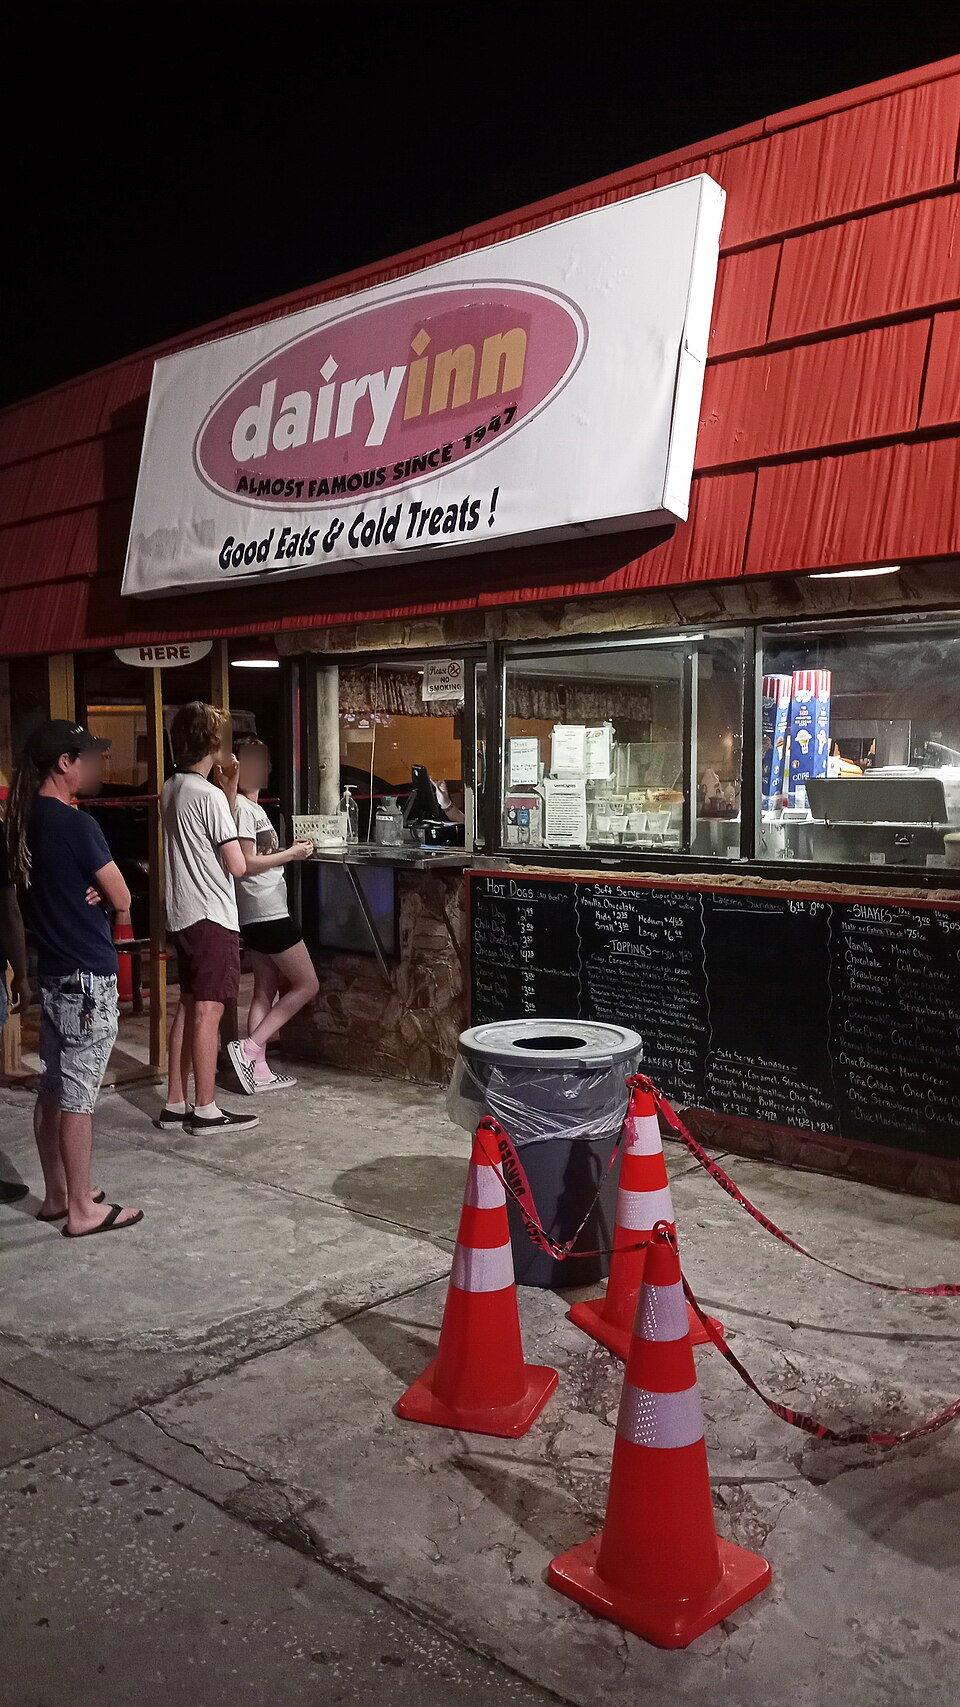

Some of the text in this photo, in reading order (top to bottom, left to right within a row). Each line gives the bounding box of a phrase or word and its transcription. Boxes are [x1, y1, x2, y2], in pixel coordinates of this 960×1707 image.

[236, 406, 518, 498] ALMOST FAMOUS SINCE 1947
[219, 529, 274, 570] Good
[275, 524, 318, 560] Eats
[322, 518, 343, 553] &
[348, 505, 401, 548] Cold
[139, 646, 190, 660] HERE
[429, 684, 461, 692] SMOKING
[852, 904, 893, 923] SHAKES
